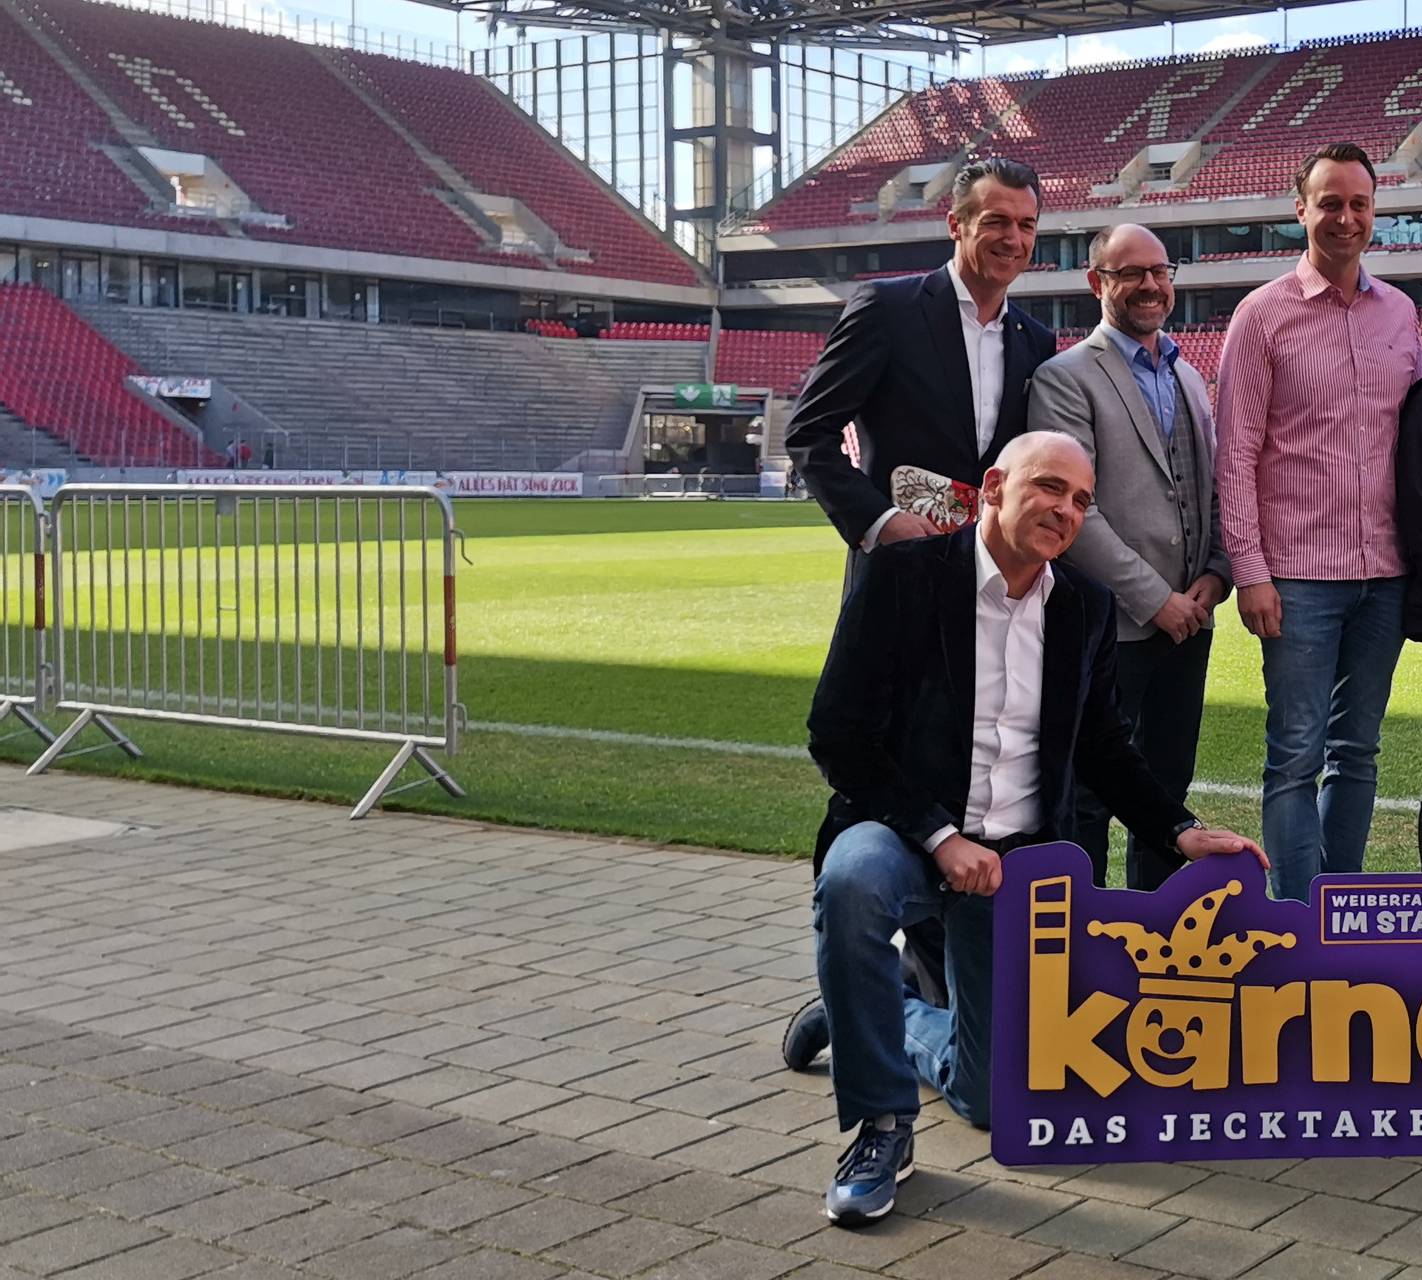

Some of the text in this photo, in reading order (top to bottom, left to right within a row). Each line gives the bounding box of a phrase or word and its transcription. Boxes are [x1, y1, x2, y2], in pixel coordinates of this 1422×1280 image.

[458, 477, 495, 492] ALLES
[1331, 911, 1368, 934] IM
[1028, 1115, 1128, 1147] DAS
